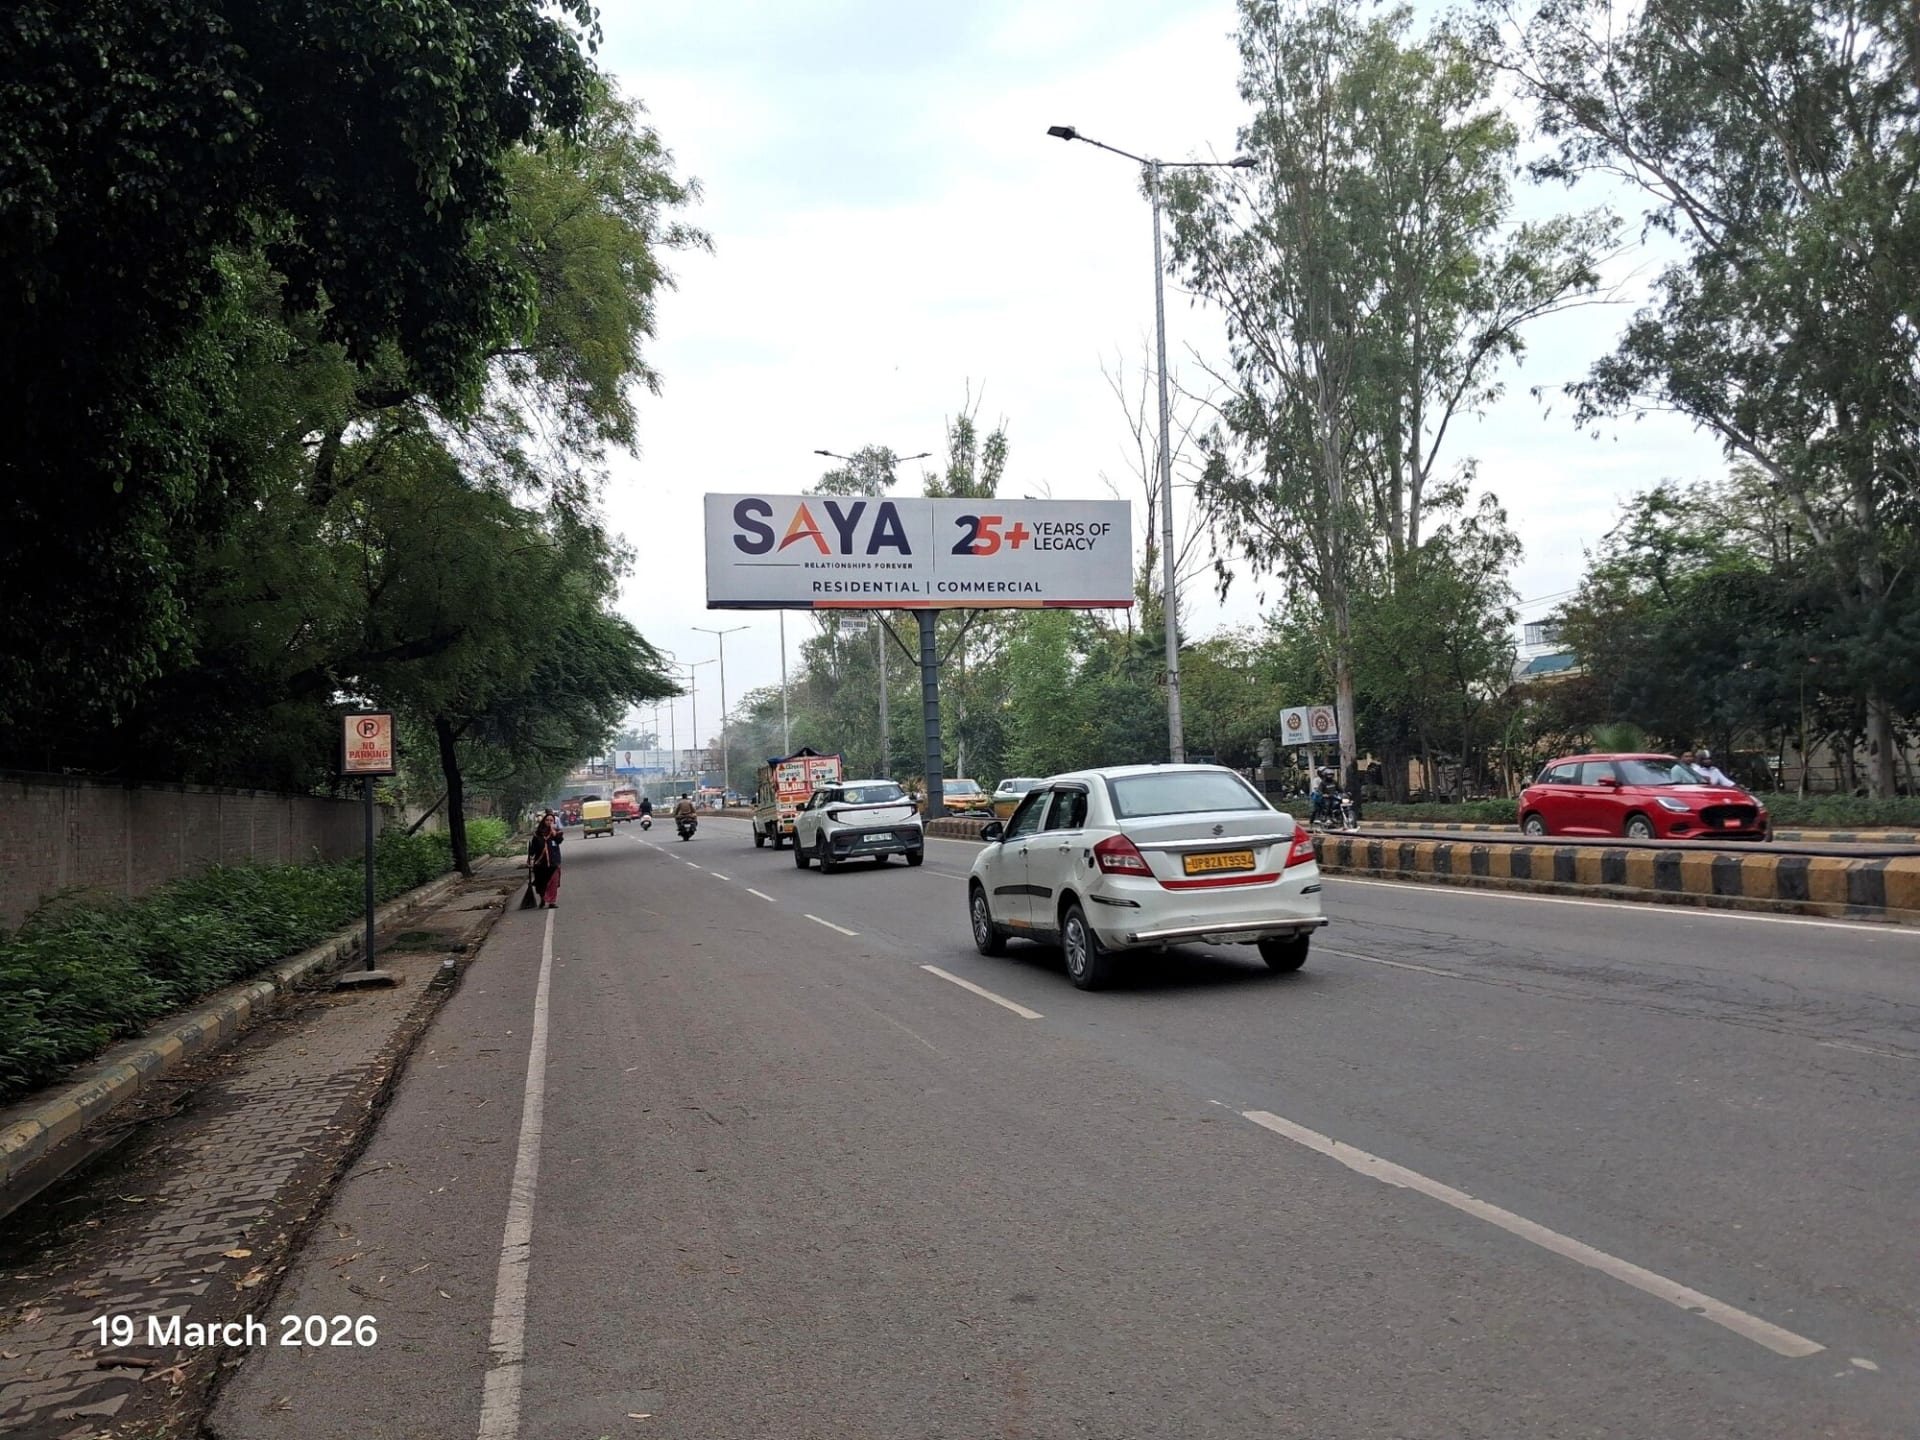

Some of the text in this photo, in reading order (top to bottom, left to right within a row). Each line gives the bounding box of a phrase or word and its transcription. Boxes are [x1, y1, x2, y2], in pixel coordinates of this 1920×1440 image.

[733, 497, 912, 555] SAYA
[1033, 522, 1111, 536] YEARS OF
[952, 514, 1030, 556] 25+
[1034, 537, 1096, 551] LEGACY
[874, 562, 913, 570] FOREVER
[812, 581, 1043, 593] RESIDENTIAL COMMERCIAL
[362, 742, 375, 750] NO
[349, 750, 388, 759] PARKING
